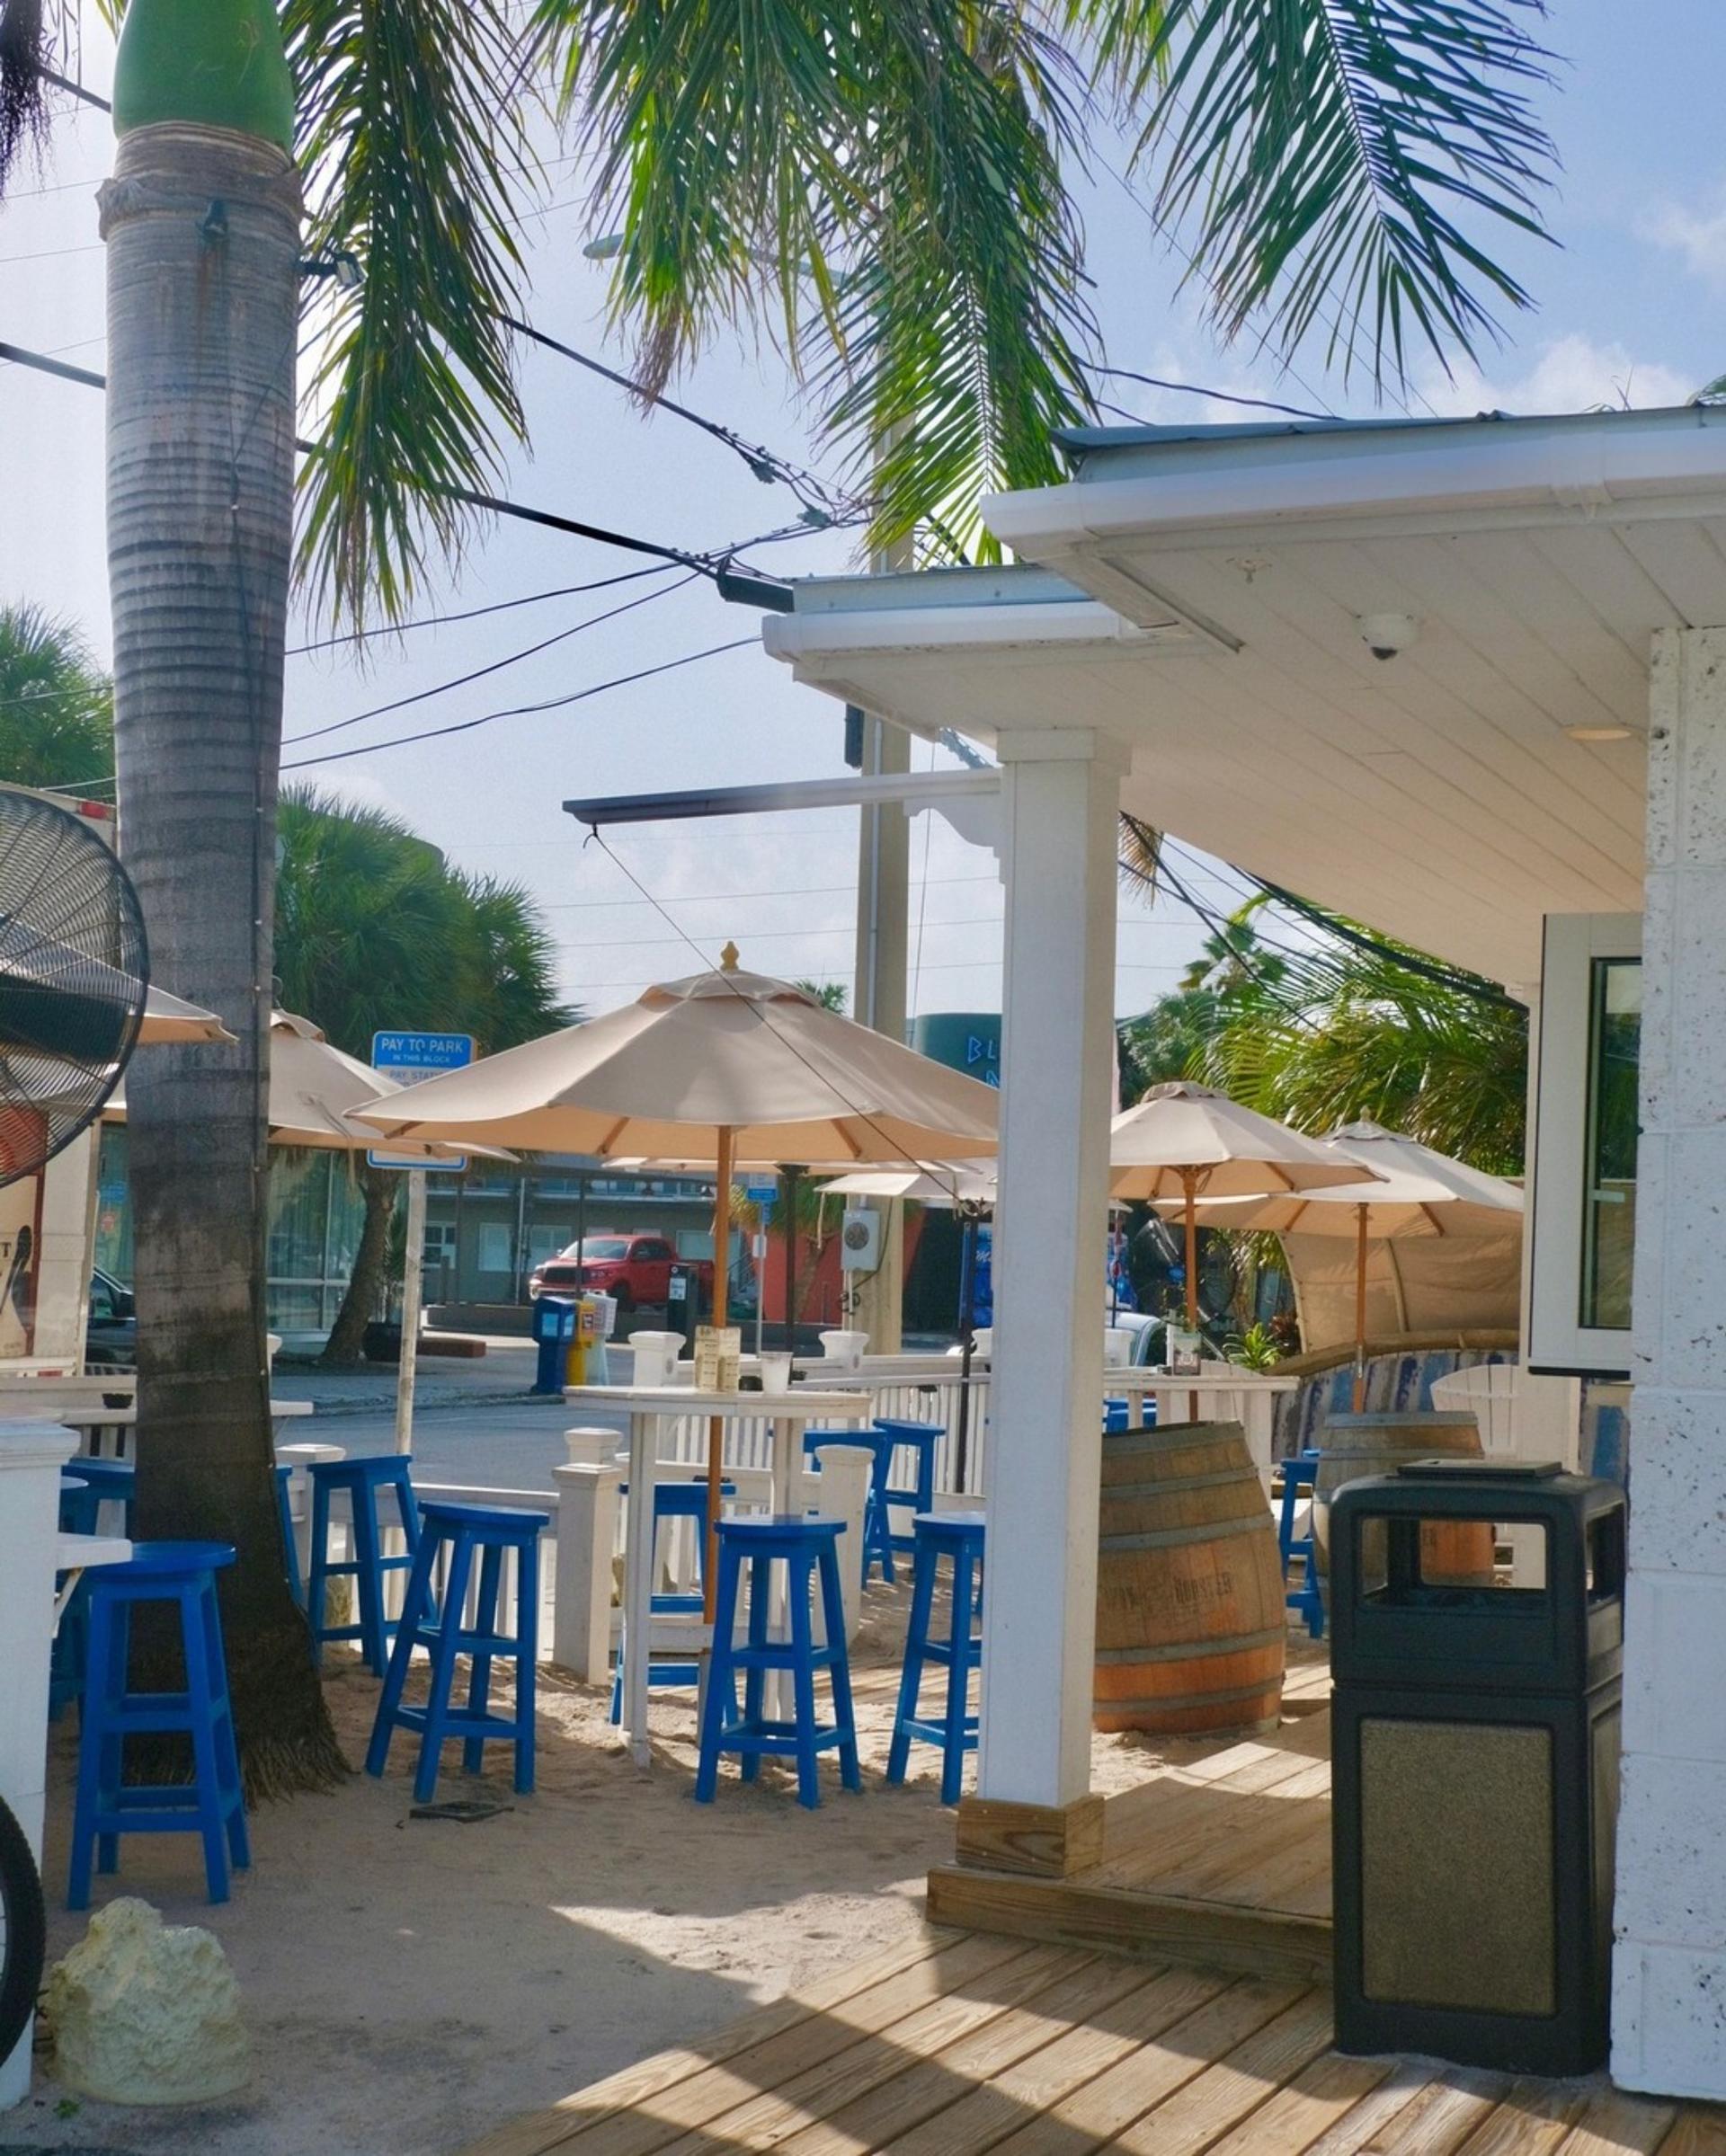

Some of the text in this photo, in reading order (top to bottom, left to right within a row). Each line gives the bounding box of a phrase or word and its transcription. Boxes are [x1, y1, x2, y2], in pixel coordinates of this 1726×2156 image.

[381, 1037, 463, 1052] PAY TO PARK
[403, 1054, 421, 1062] THIS
[423, 1055, 450, 1063] BLOCK
